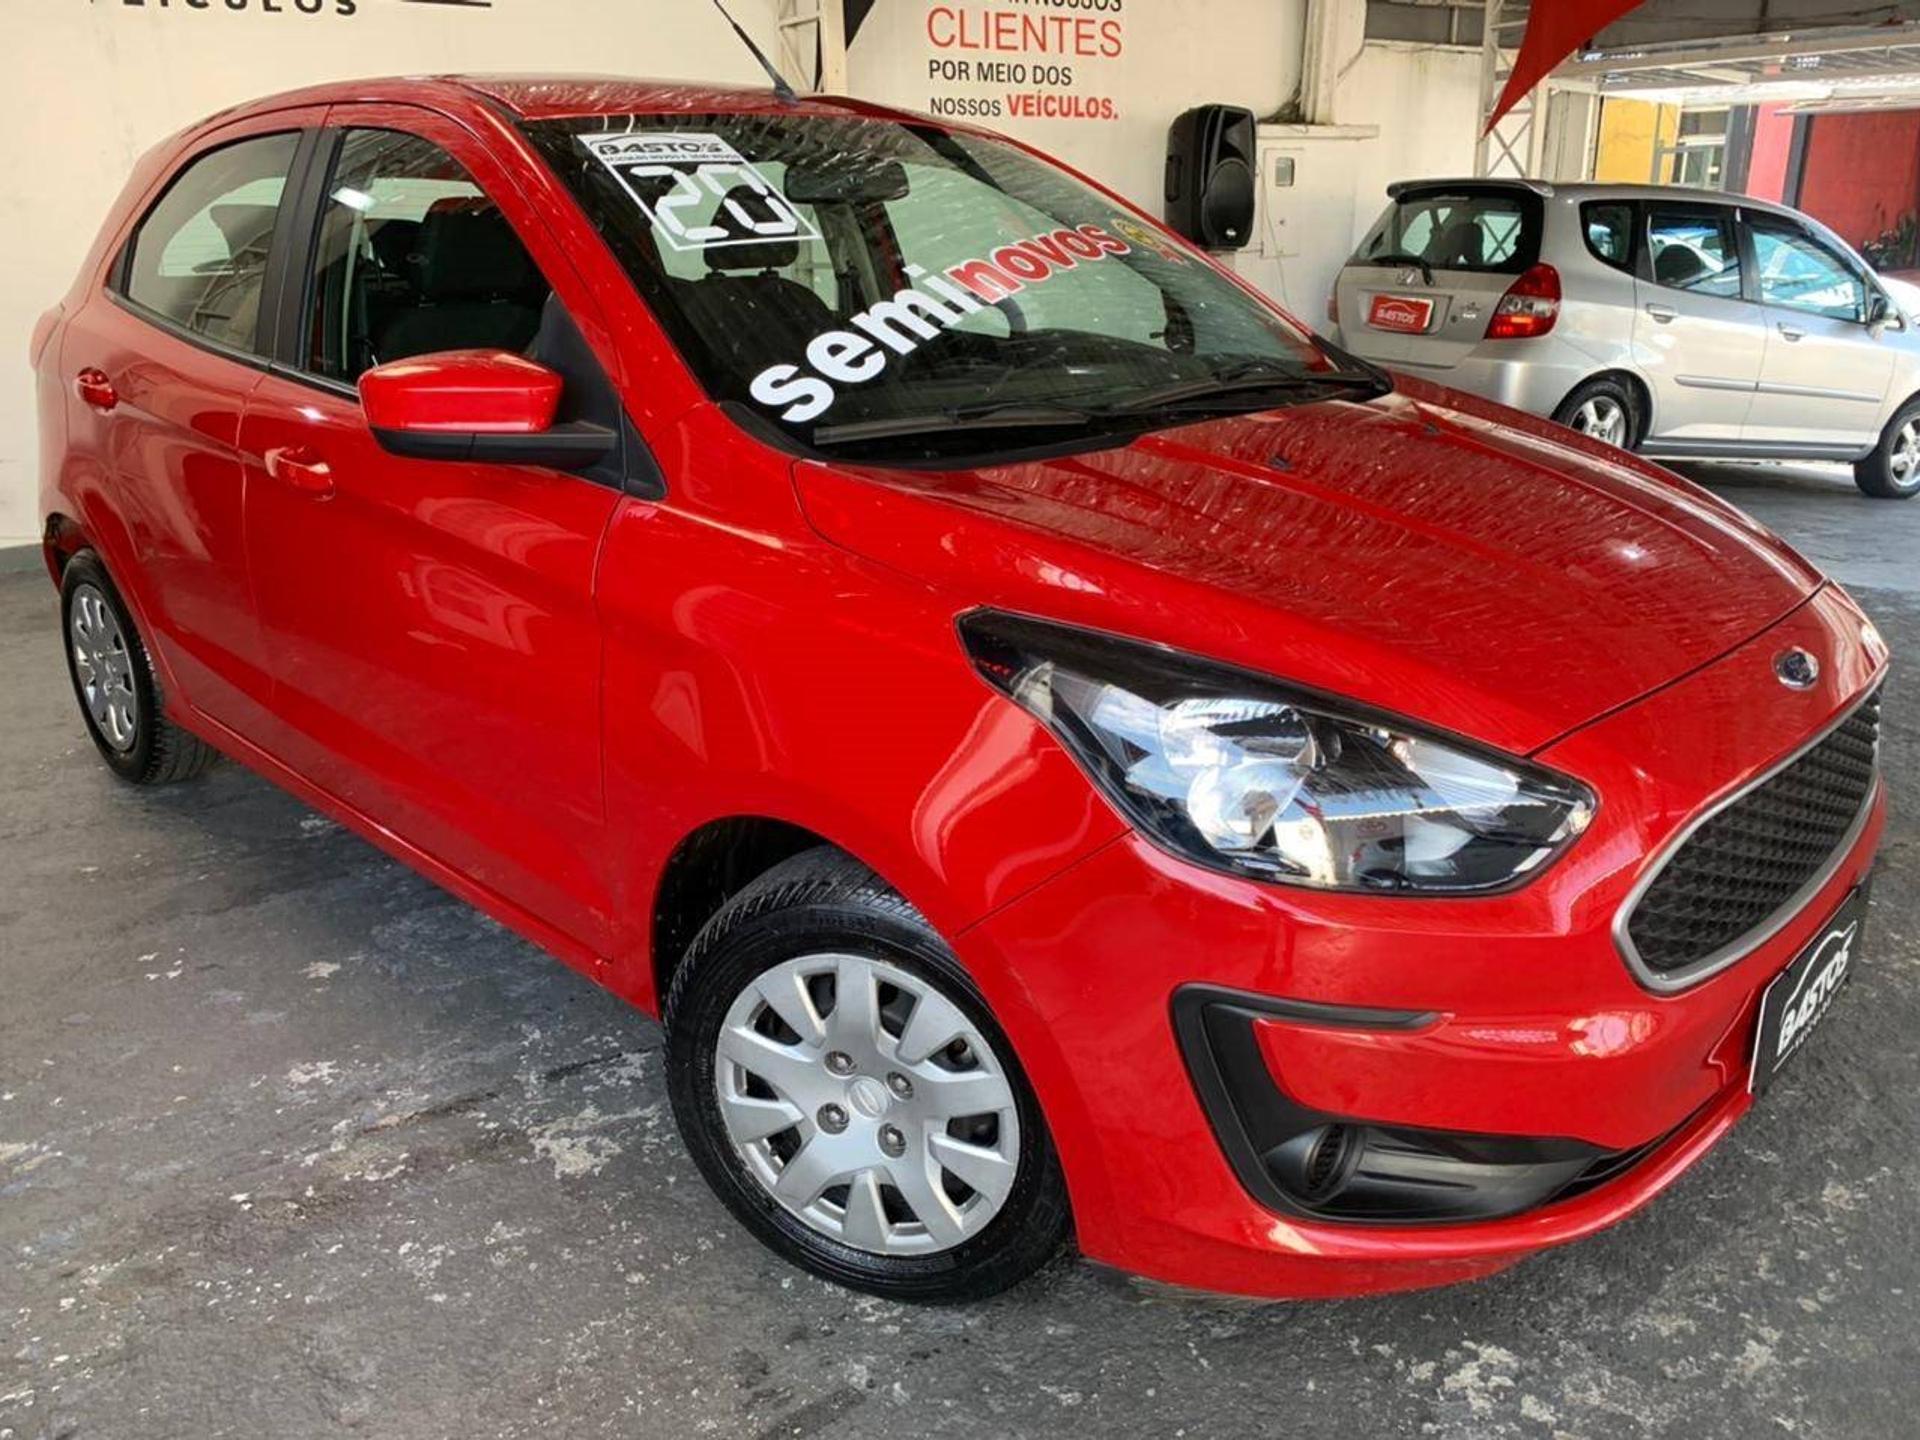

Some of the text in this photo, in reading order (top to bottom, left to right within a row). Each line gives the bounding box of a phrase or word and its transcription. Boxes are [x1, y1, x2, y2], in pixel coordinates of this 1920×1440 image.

[927, 7, 1122, 57] CLIENTES
[929, 59, 1073, 86] POR MEIO DOS
[930, 89, 1119, 120] NOSSOS VEÍCULOS.
[629, 164, 798, 240] 20
